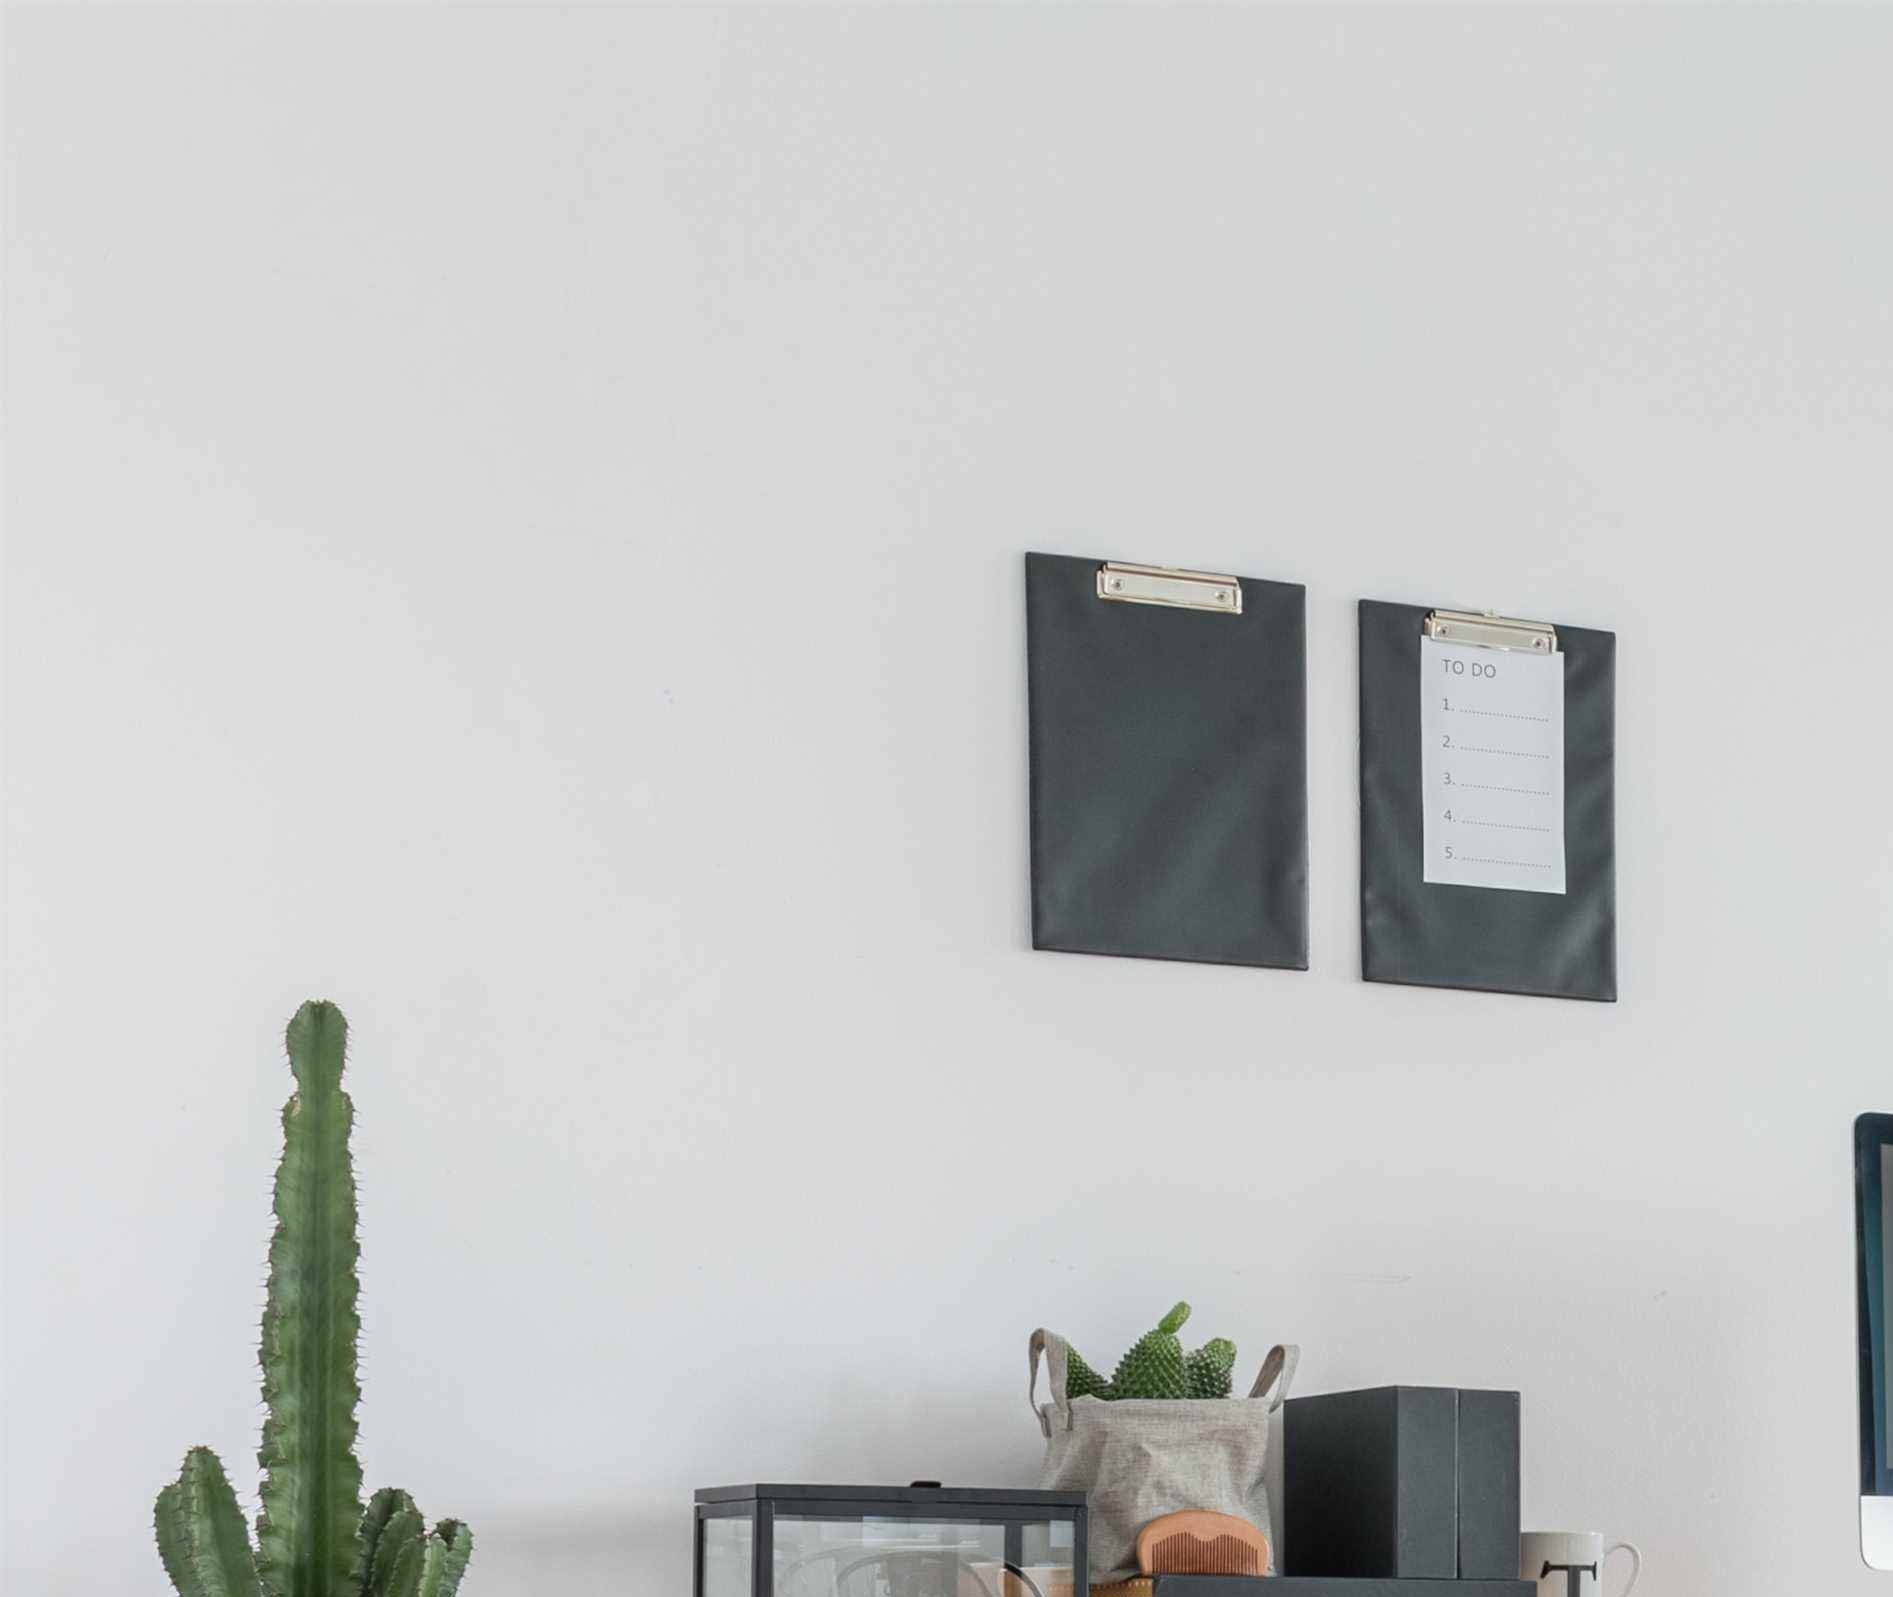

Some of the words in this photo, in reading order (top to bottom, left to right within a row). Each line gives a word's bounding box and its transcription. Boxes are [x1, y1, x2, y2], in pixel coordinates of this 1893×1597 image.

[1441, 658, 1465, 675] TO
[1471, 661, 1497, 679] DO
[1442, 697, 1456, 712] 1.
[1442, 734, 1456, 750] 2.
[1442, 771, 1457, 786] 3.
[1443, 808, 1457, 823] 4.
[1444, 845, 1458, 860] 5.
